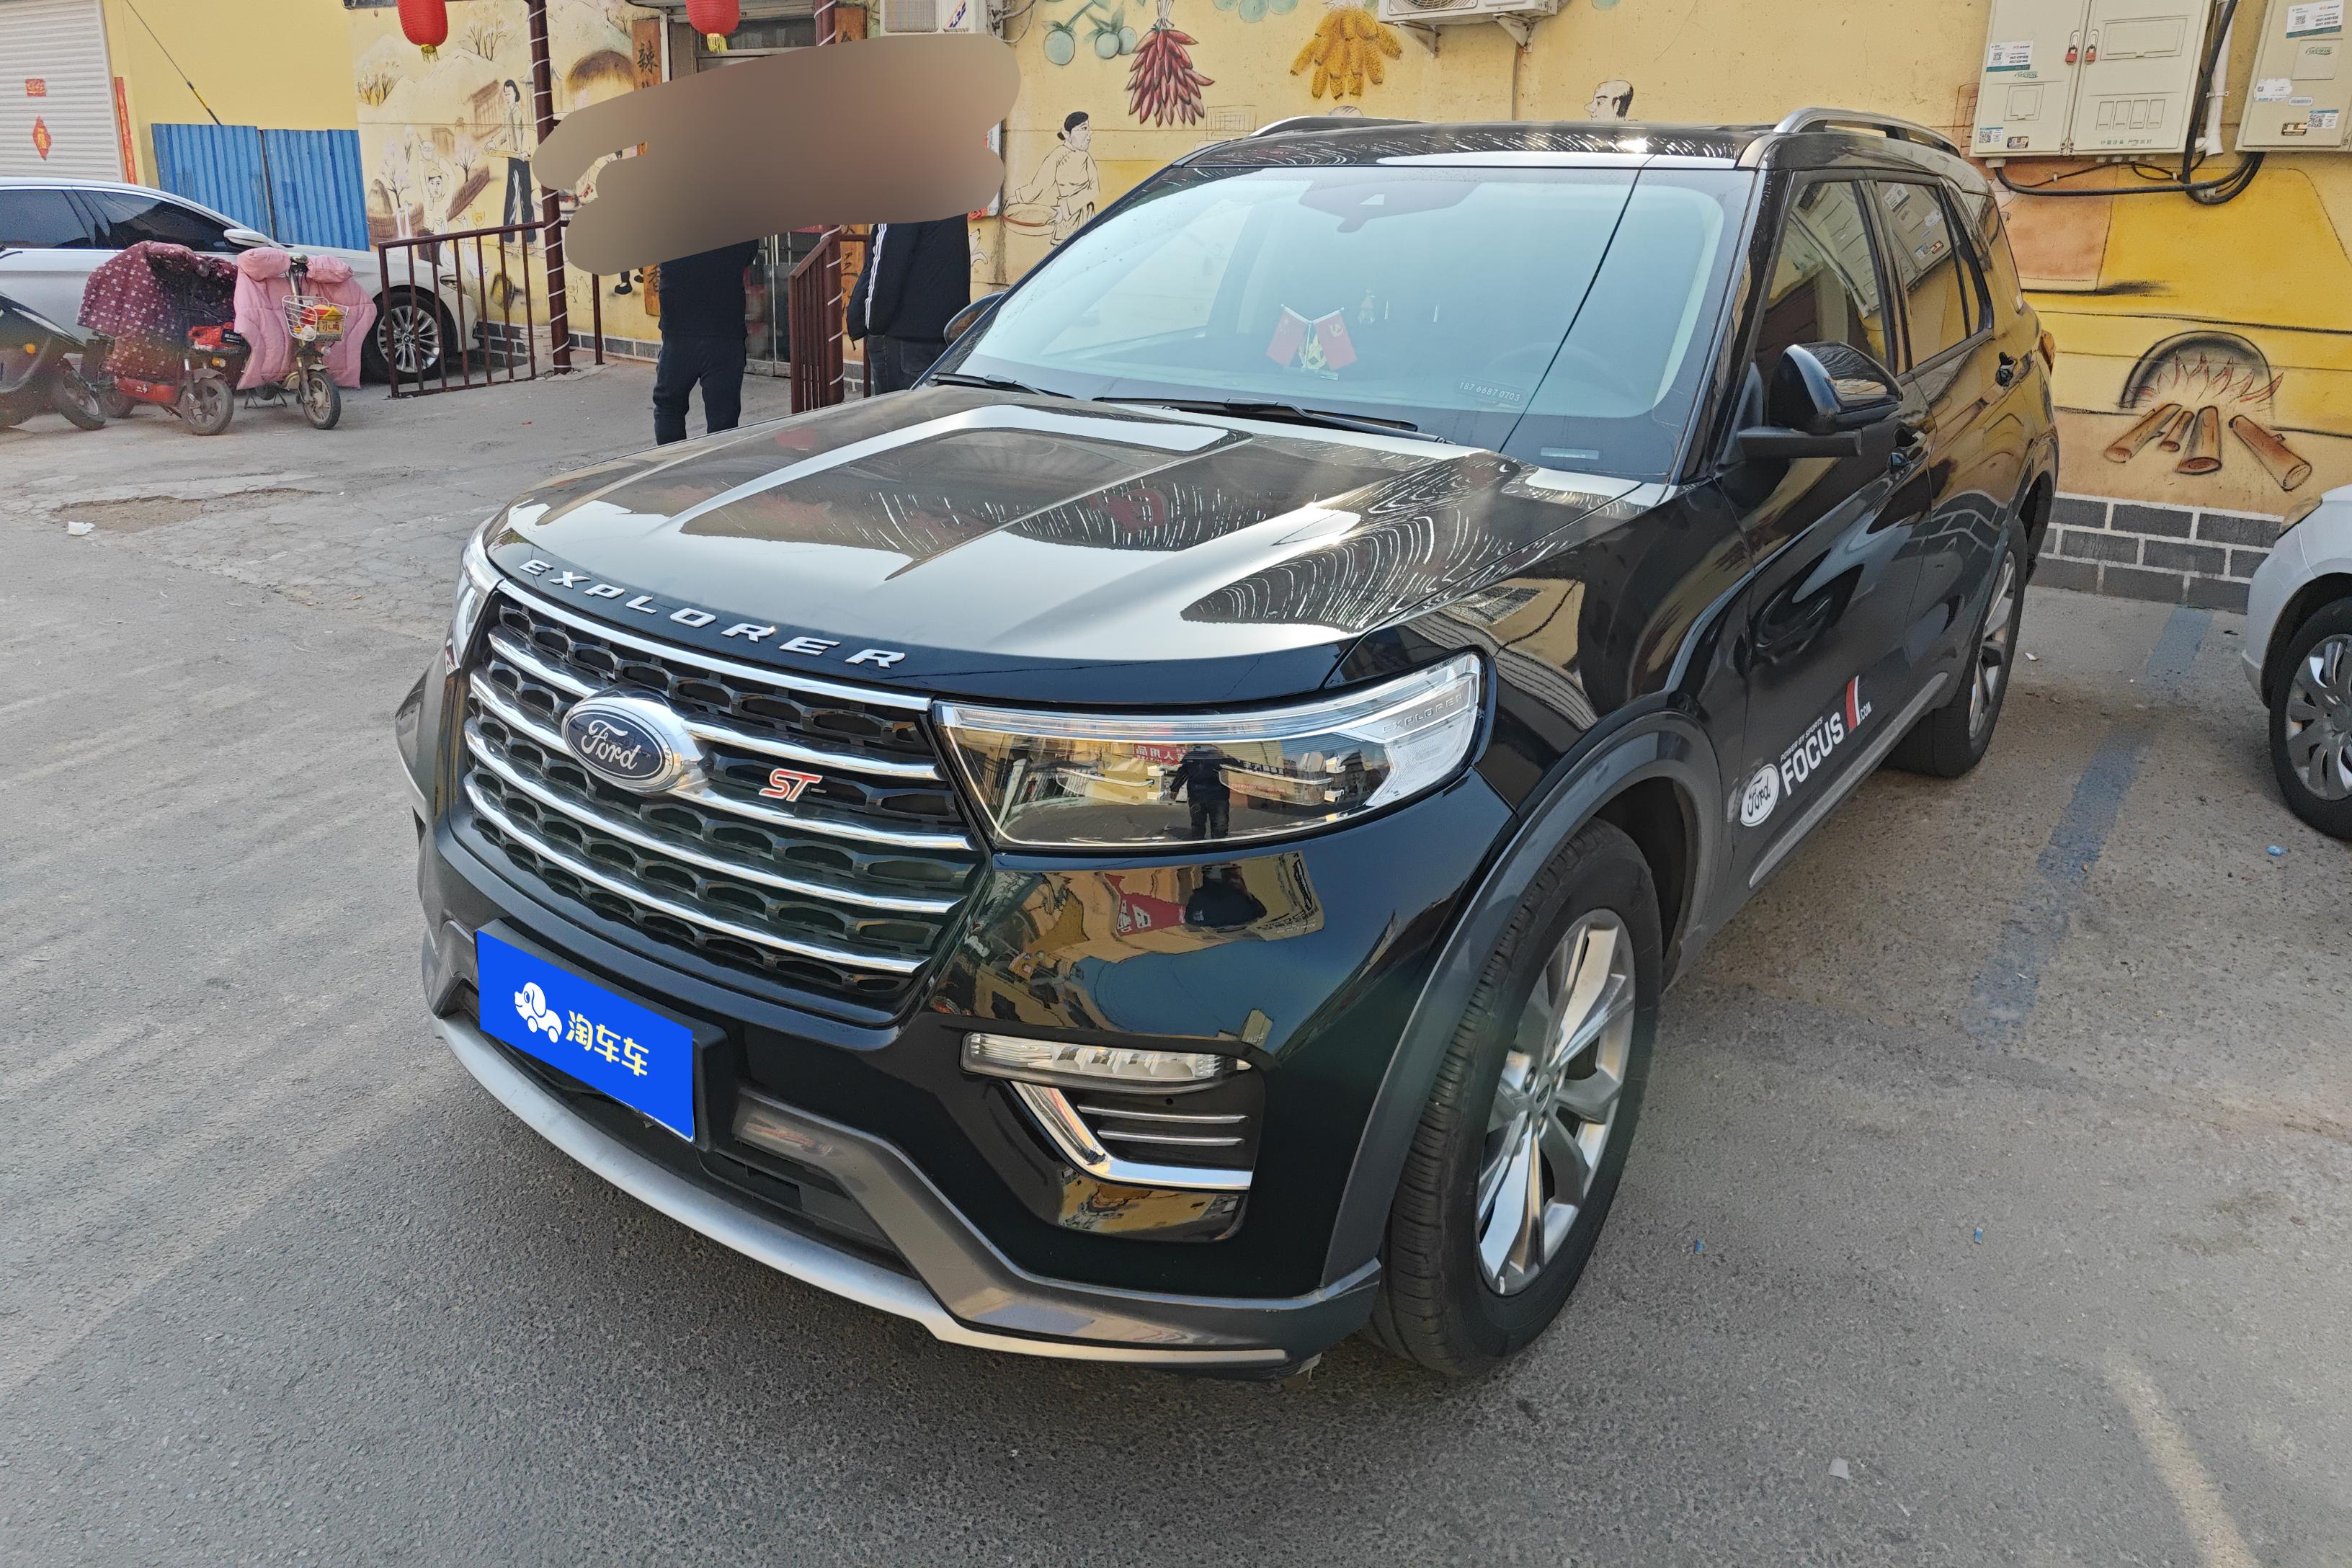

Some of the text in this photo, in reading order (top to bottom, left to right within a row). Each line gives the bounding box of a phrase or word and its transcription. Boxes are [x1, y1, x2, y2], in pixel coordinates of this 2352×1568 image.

[1459, 381, 1520, 401] 187 6687 0703
[519, 558, 905, 669] EXPLORER
[1383, 693, 1463, 733] EXPLORER
[580, 718, 643, 770] Ford
[1780, 739, 1798, 764] POWER
[1805, 716, 1823, 739] SPORTS
[759, 768, 823, 802] ST
[1747, 775, 1772, 818] Ford
[1781, 711, 1845, 797] FOCUS
